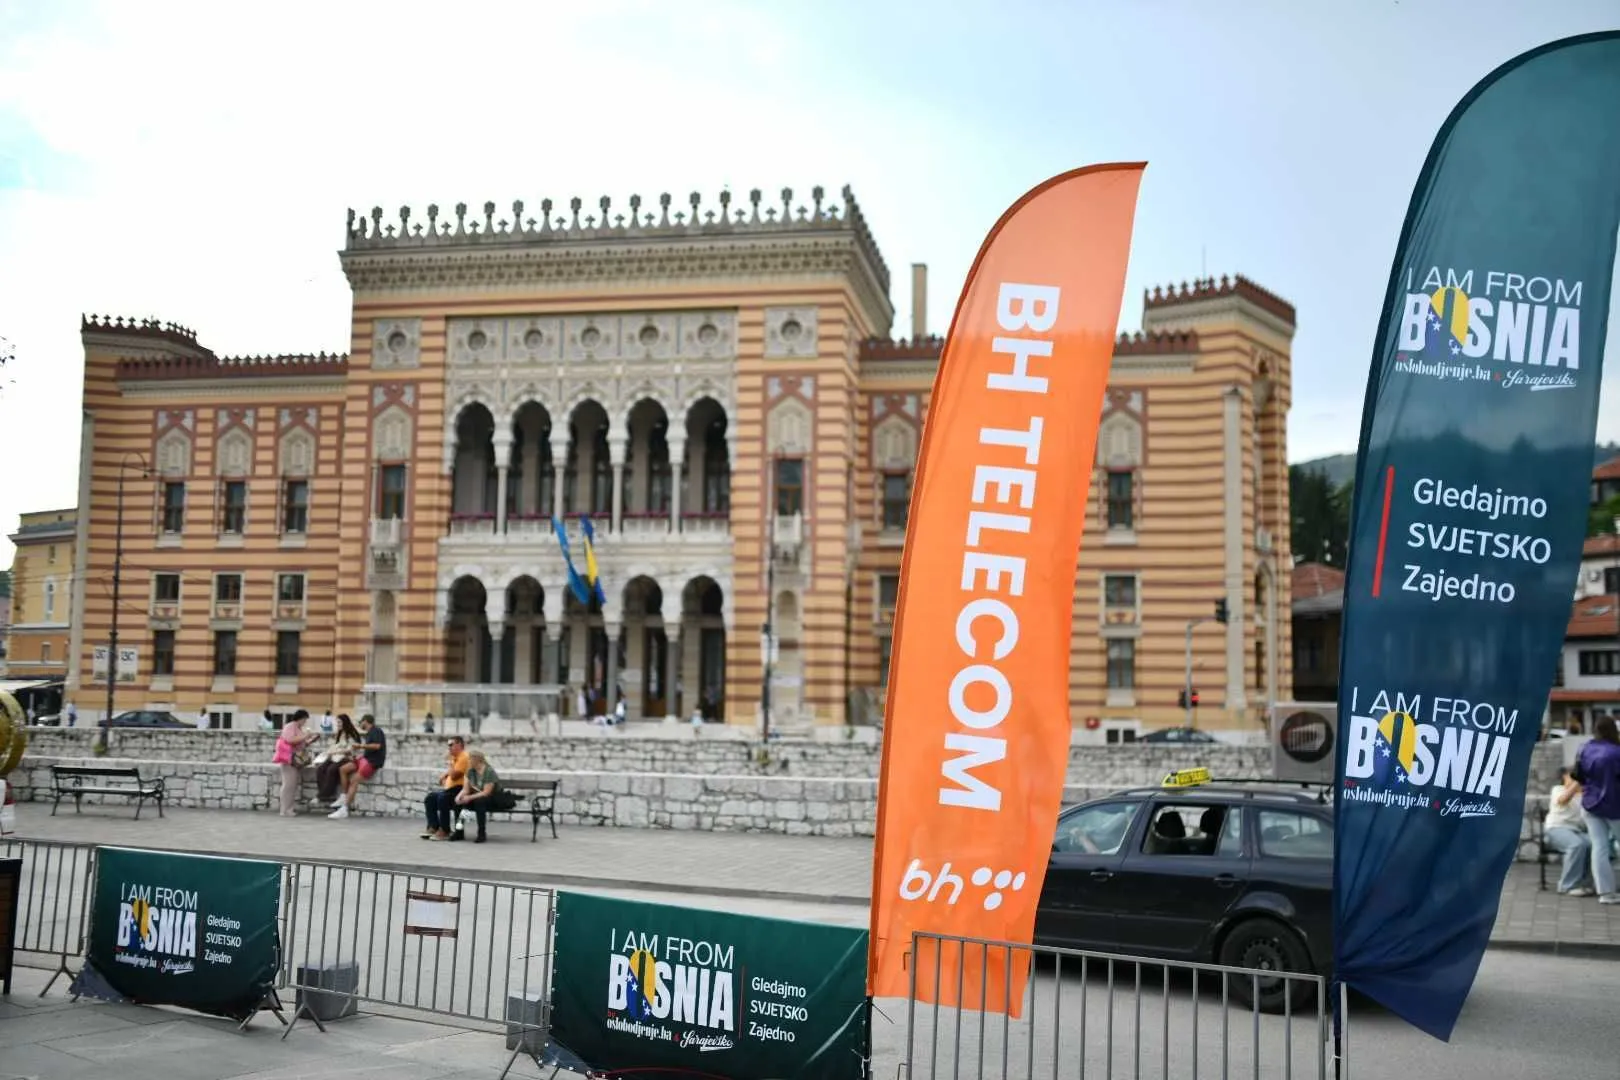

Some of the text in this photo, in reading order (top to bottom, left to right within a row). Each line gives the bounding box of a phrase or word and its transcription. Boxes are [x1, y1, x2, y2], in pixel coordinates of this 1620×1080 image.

[1406, 266, 1583, 306] I AM FROM
[1398, 287, 1580, 370] BOSNIA
[1413, 478, 1548, 520] Gledajmo
[938, 282, 1061, 813] BH TELECOM
[1407, 522, 1552, 564] SVJETSKO
[1401, 564, 1516, 603] Zajedno
[1351, 686, 1519, 735] I AM FROM
[1345, 711, 1511, 798] BOSNIA
[120, 882, 198, 910] I AM FROM
[898, 858, 965, 905] bh
[117, 899, 197, 958] BOSNIA
[205, 932, 242, 948] SVJETSKO
[207, 914, 240, 931] Gledajmo
[204, 949, 232, 964] Zajedno
[610, 927, 735, 970] I AM FROM
[608, 949, 734, 1032] BOSNIA
[751, 976, 807, 999] Gledajmo
[750, 999, 809, 1022] SVJETSKO
[748, 1022, 796, 1043] Zajedno
